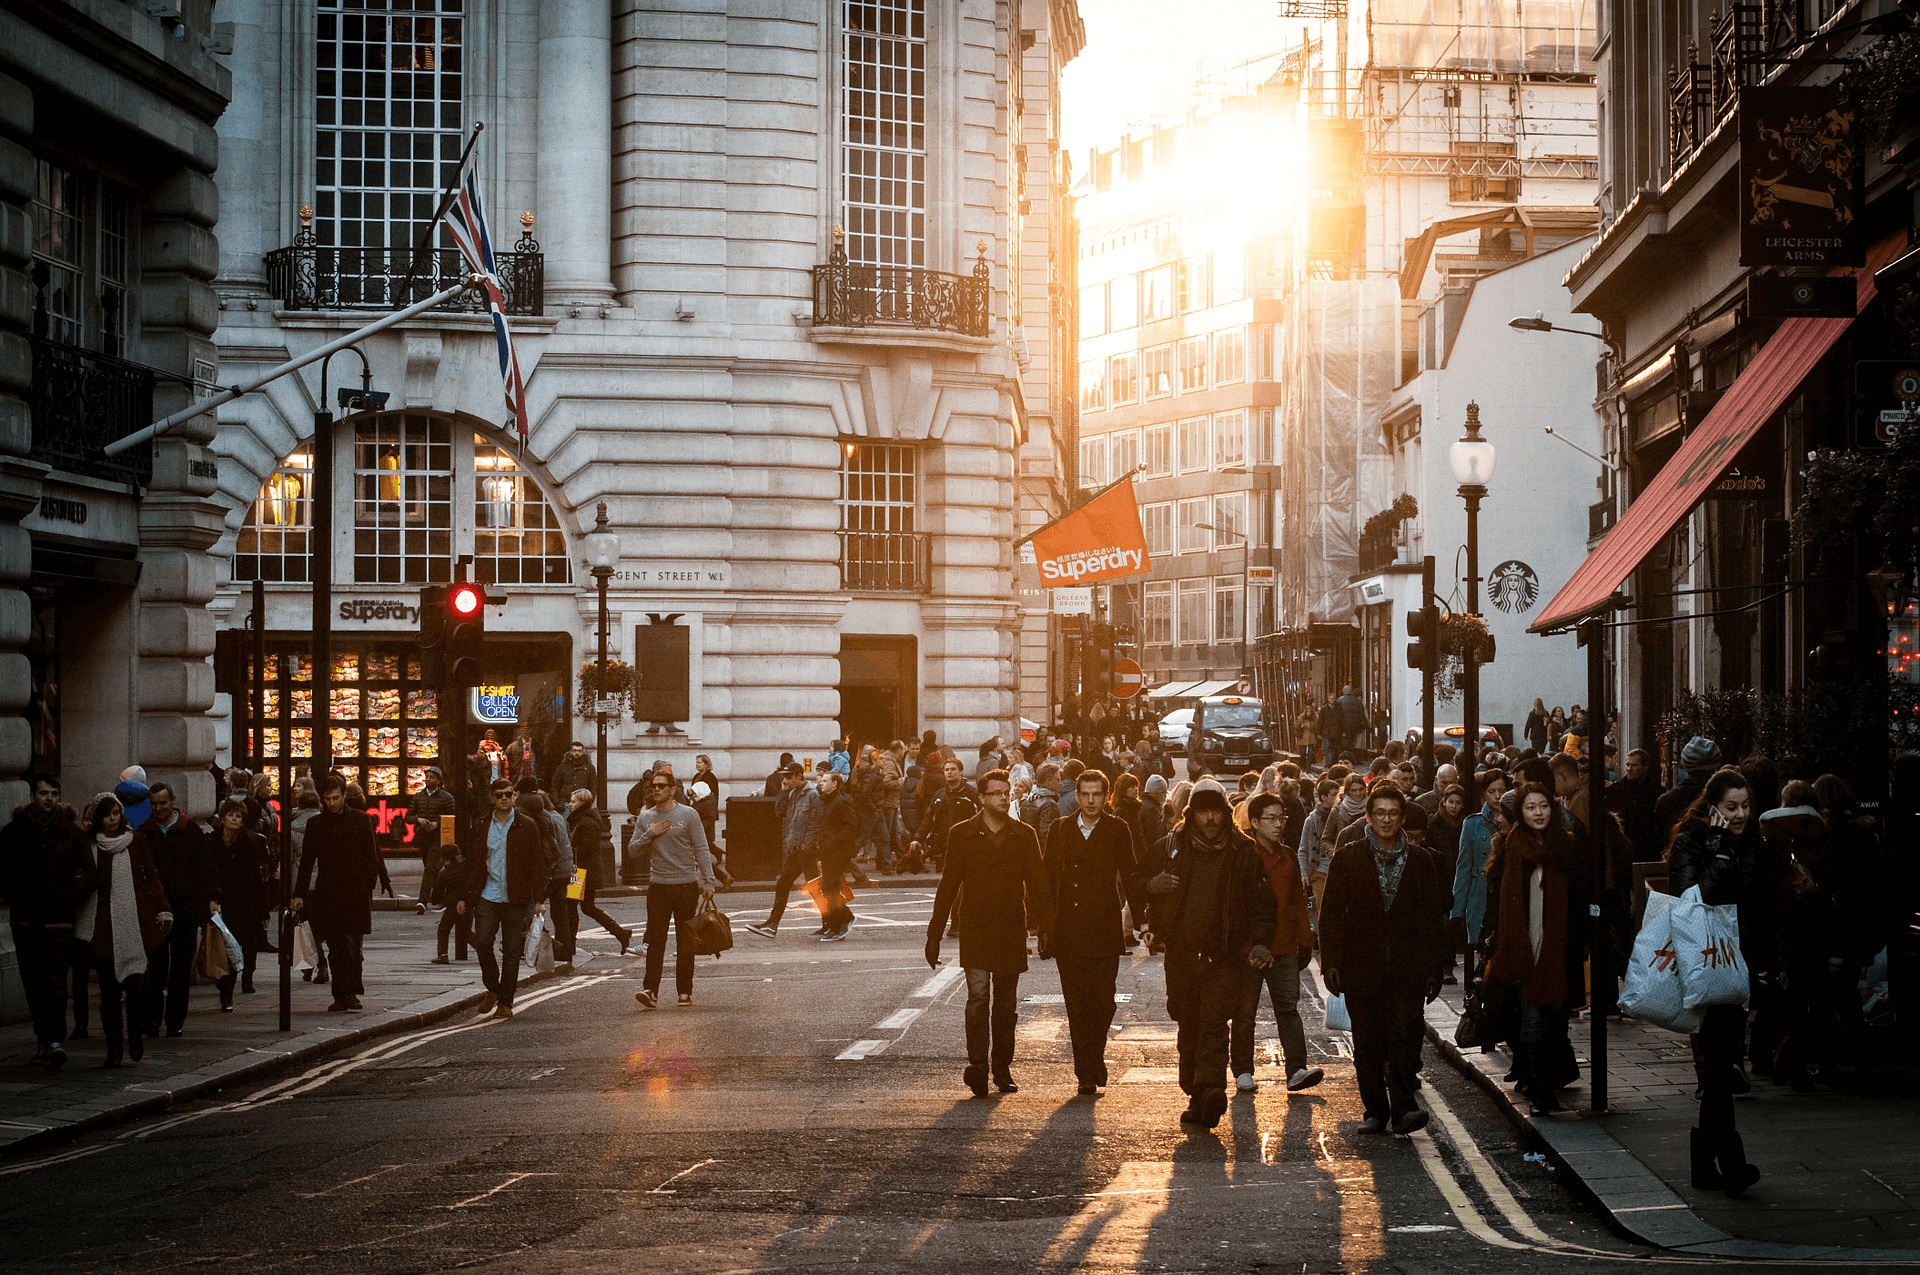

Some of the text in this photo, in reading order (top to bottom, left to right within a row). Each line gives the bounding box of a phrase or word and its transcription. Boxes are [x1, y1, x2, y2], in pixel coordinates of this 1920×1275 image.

[1765, 237, 1843, 248] LEICESTER
[1784, 251, 1825, 261] ARMS
[1882, 412, 1906, 420] PROUD
[1715, 475, 1766, 491] ando's
[1042, 547, 1142, 580] Superdry
[609, 571, 648, 581] GENT
[657, 571, 701, 581] STREET
[340, 602, 422, 624] Superdry
[1859, 801, 1880, 809] AWAY
[1701, 934, 1739, 971] H&M
